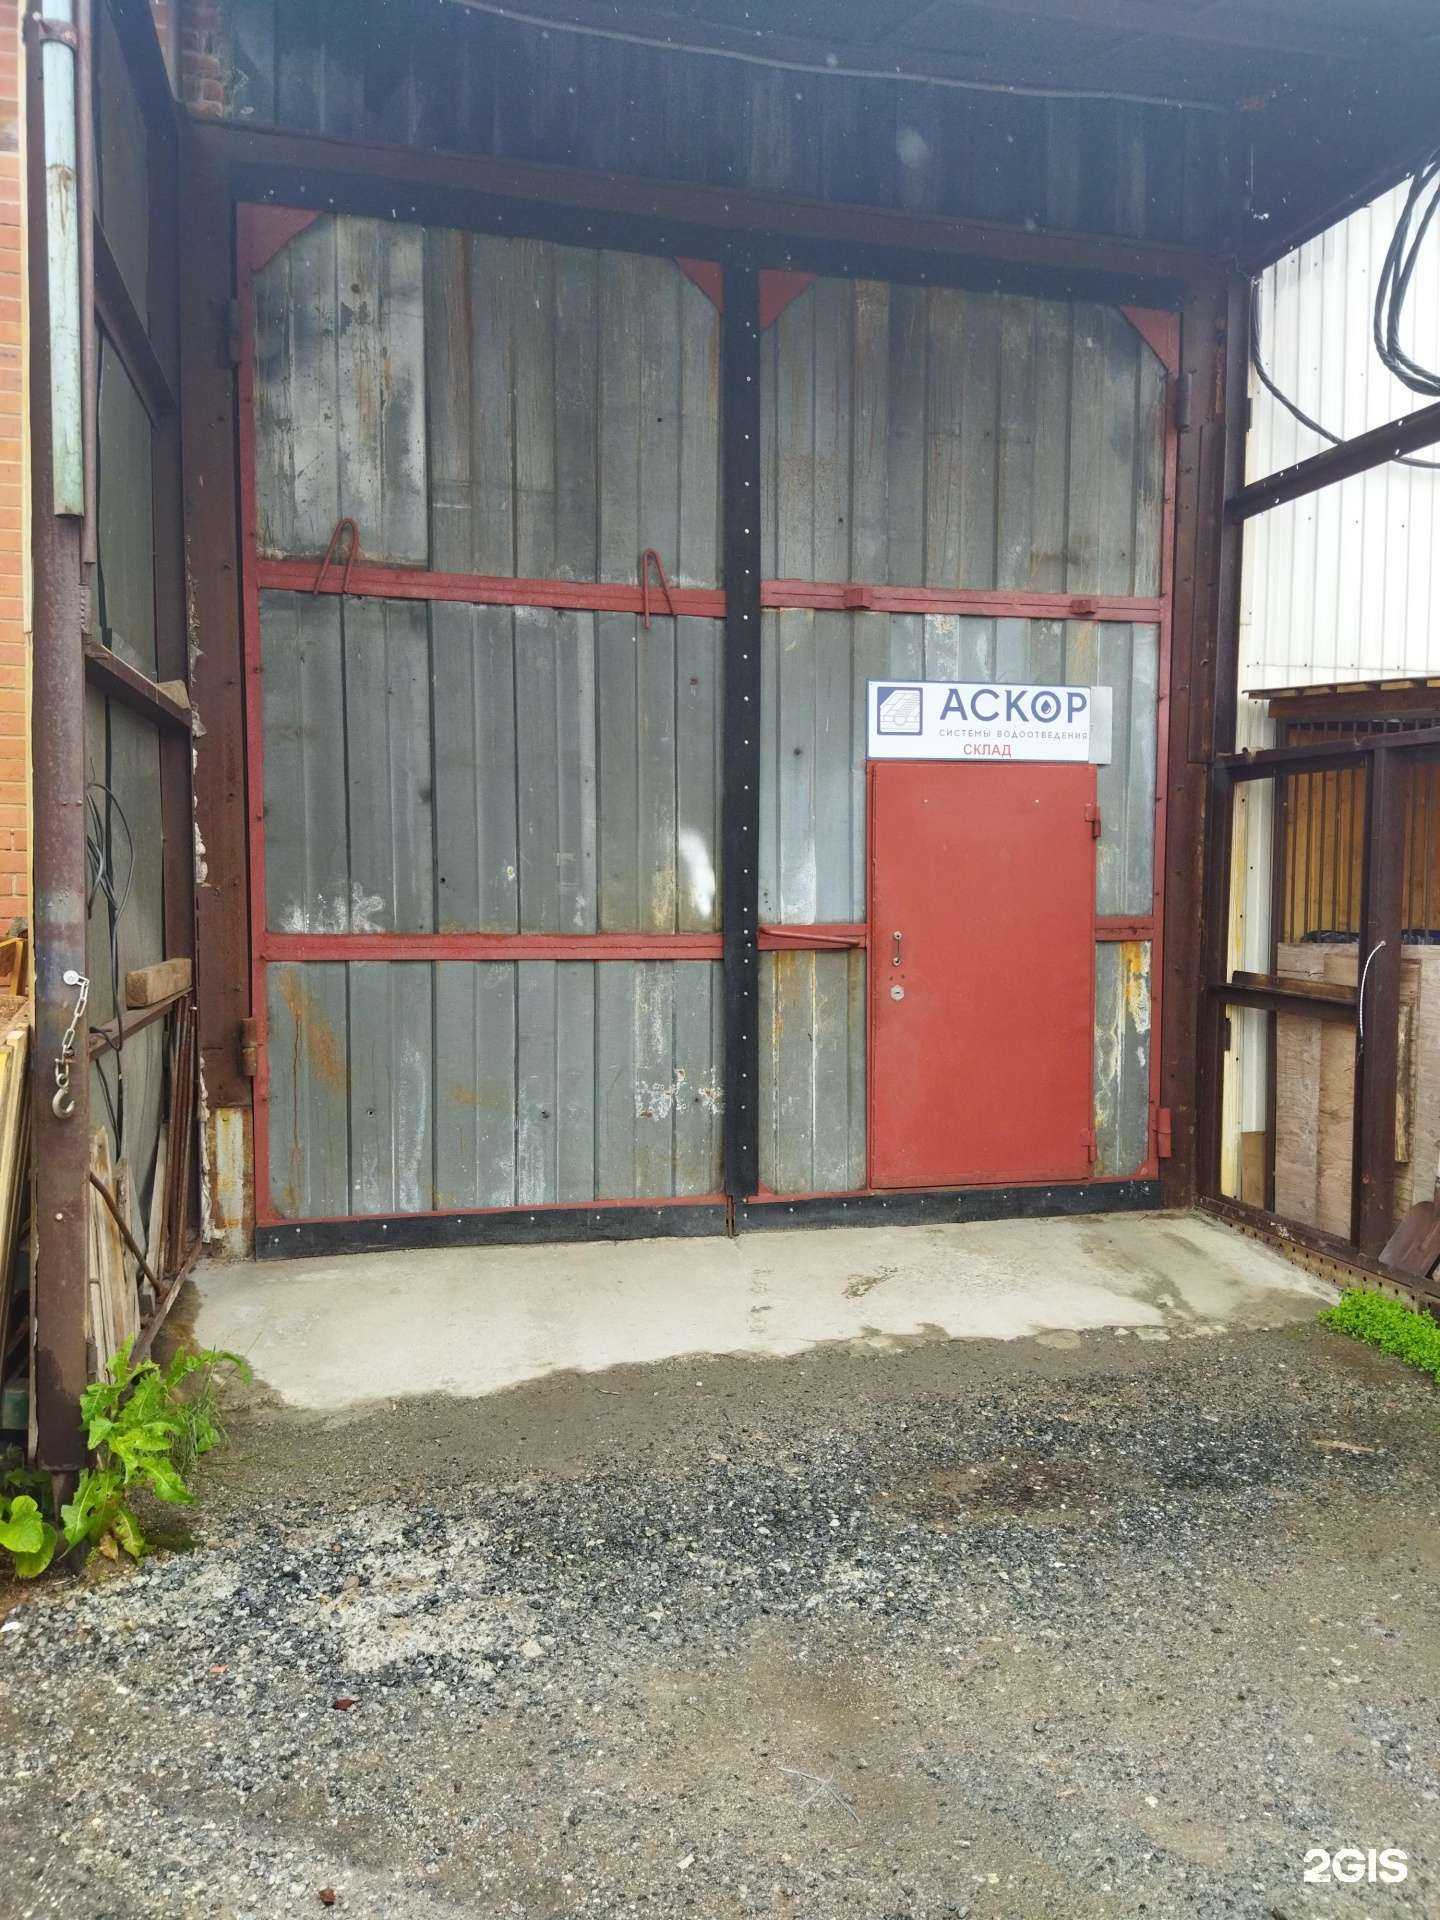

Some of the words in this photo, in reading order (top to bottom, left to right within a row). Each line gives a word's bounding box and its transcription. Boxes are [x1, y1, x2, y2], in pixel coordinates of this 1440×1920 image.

[939, 688, 1088, 723] АСКОР
[939, 728, 991, 737] СИСТЕМЫ
[997, 729, 1088, 740] ВОДООТВЕДЕНИЯ
[963, 743, 1012, 758] СКЛАД
